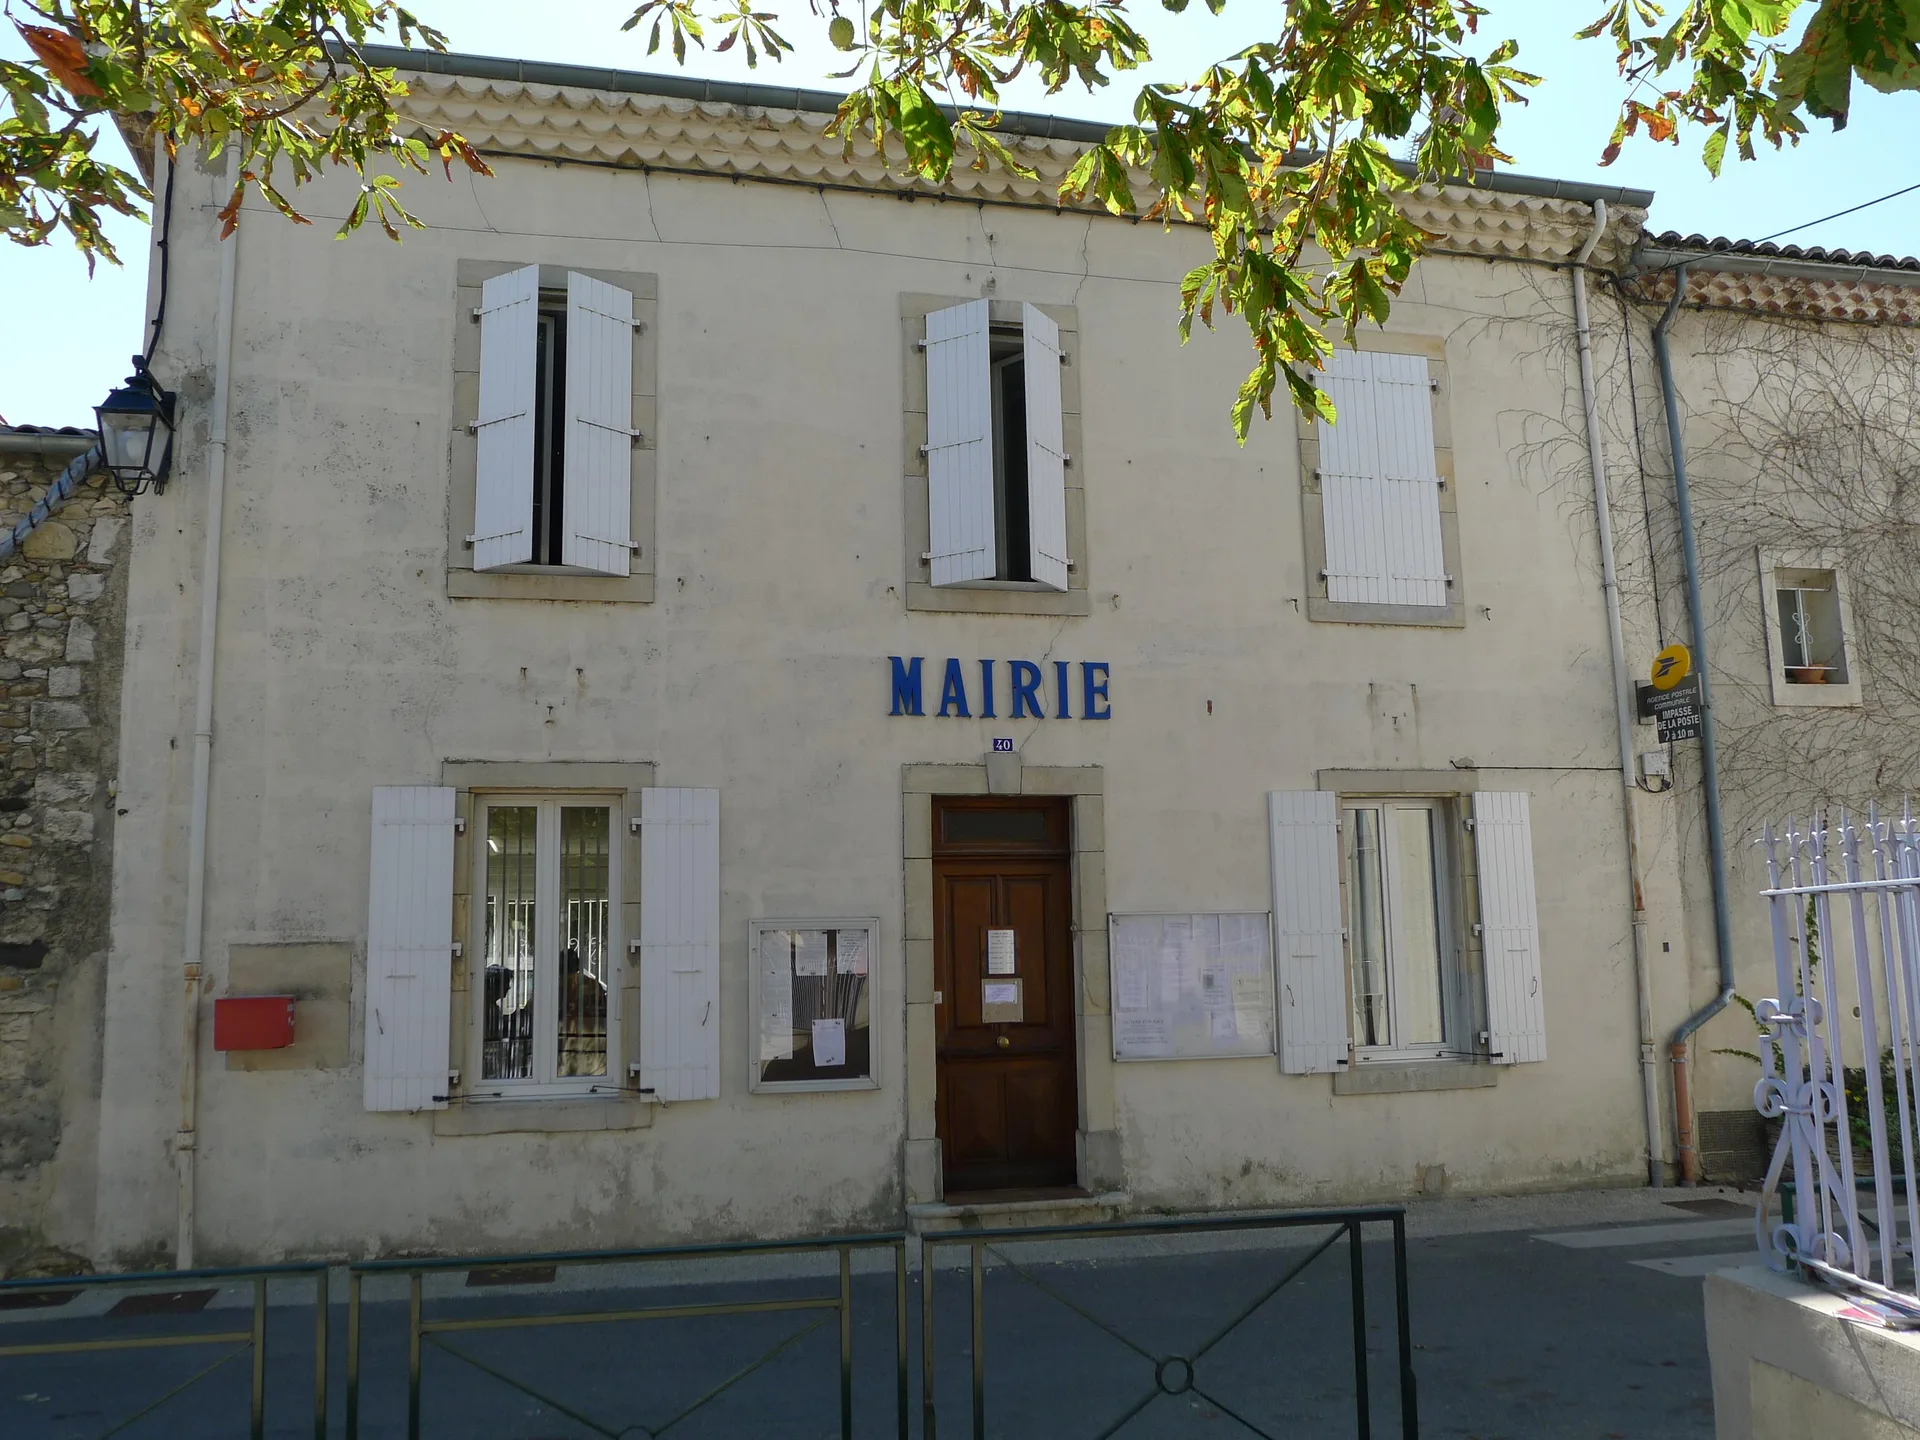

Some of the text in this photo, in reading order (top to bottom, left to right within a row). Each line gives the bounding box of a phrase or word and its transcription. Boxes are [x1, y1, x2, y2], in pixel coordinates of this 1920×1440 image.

[887, 656, 1111, 720] MAIRIE
[1647, 687, 1697, 703] AGENCE POSTALE
[1654, 696, 1691, 710] COMMUNALE
[1662, 706, 1692, 719] IMPASSE
[1658, 714, 1699, 731] DE LA POSTE
[1671, 729, 1694, 740] à 10 m
[995, 740, 1011, 750] 40
